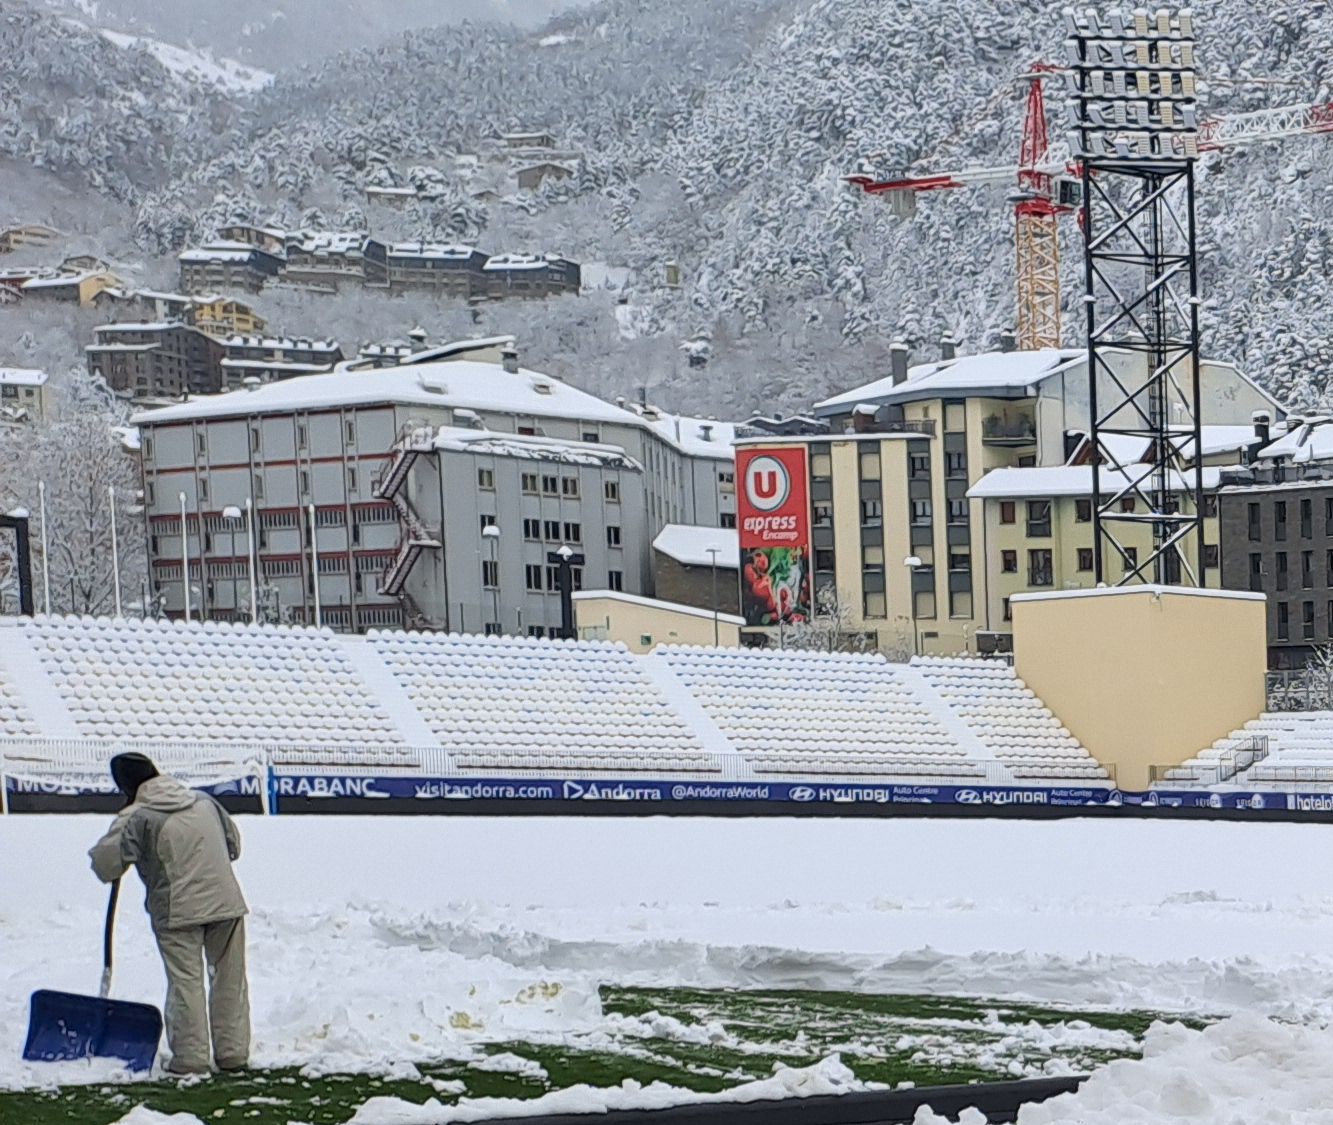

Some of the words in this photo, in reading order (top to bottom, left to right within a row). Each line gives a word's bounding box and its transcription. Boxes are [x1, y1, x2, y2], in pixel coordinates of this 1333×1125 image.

[754, 471, 777, 498] U
[744, 515, 797, 535] express
[415, 781, 552, 799] visitandorra.com
[583, 782, 661, 800] Andorra
[671, 784, 769, 799] @AndorraWorld
[819, 787, 889, 803] HYUNDAI
[983, 790, 1048, 803] HYUNDAI
